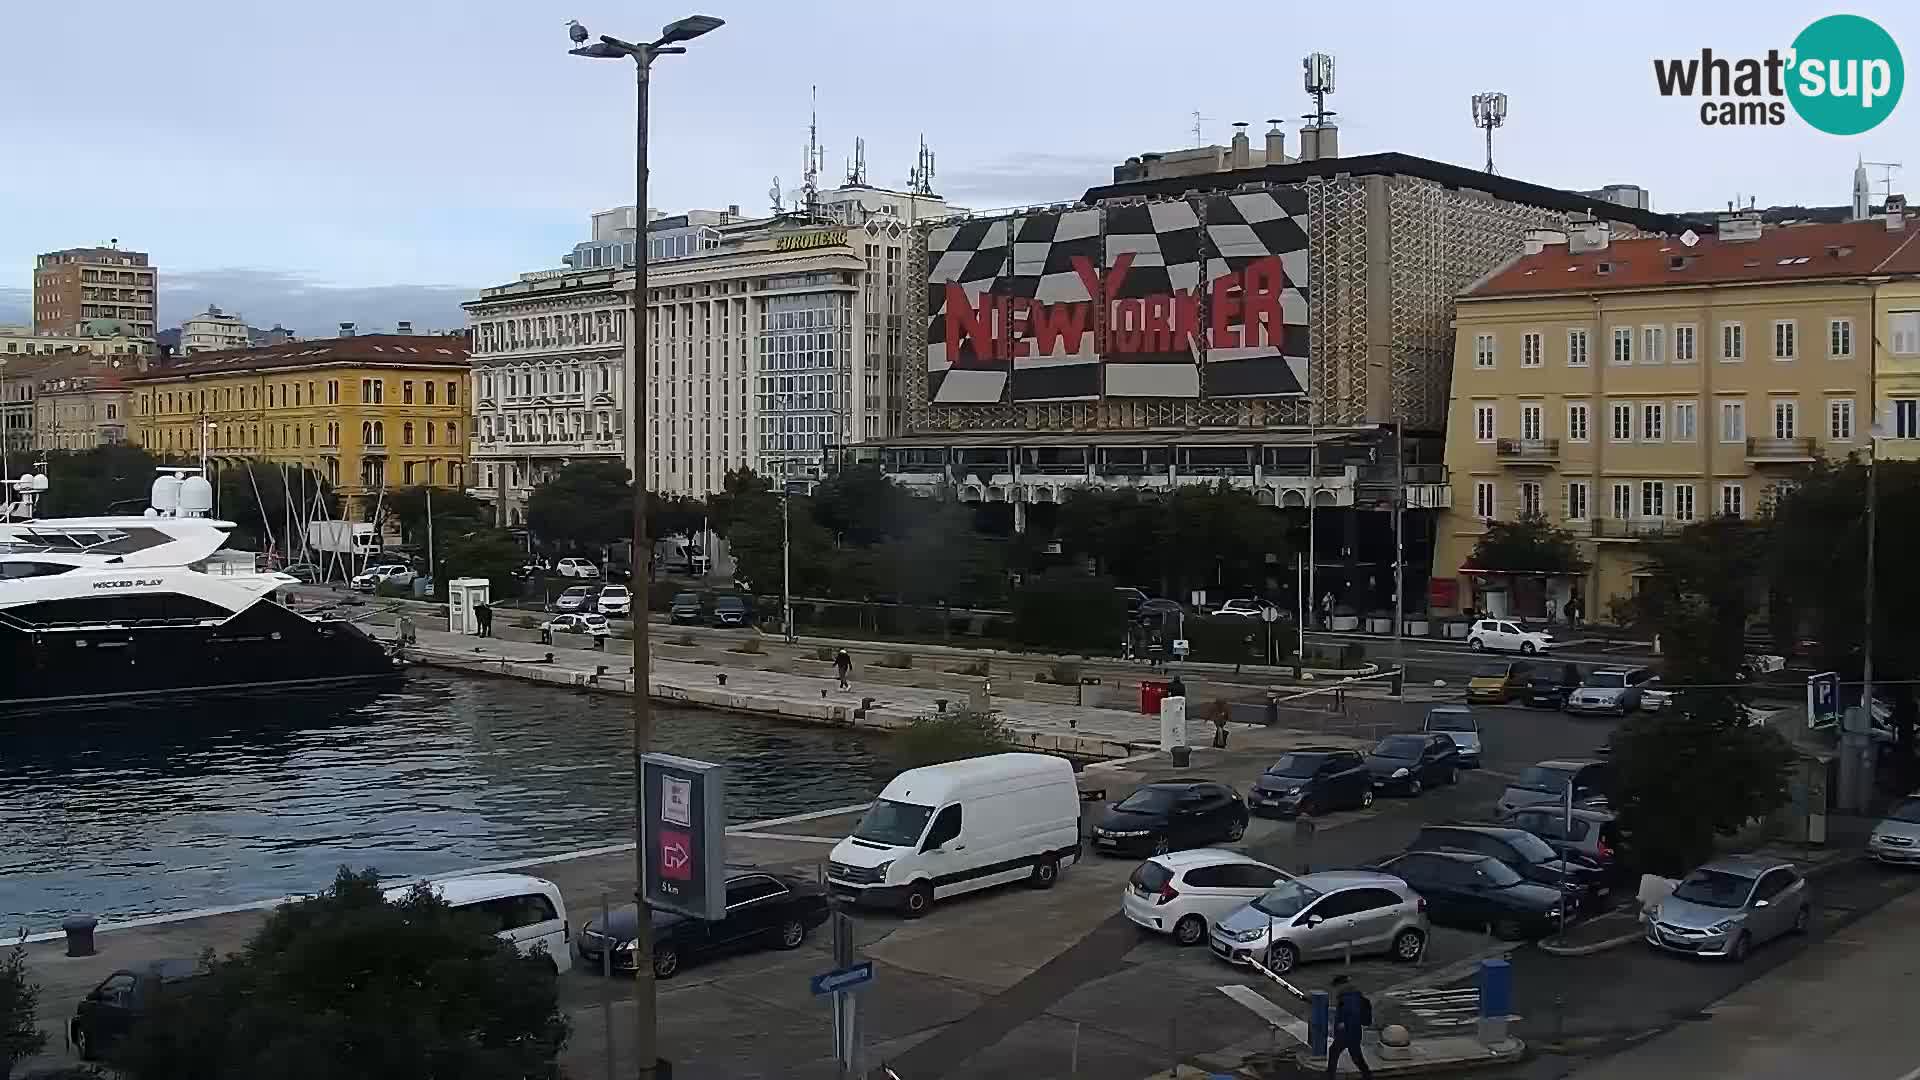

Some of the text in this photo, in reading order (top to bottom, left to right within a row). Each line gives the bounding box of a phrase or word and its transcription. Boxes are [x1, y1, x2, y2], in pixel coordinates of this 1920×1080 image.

[945, 252, 1284, 364] NEW YORKER
[93, 579, 163, 589] WICKED PLAY
[1819, 680, 1831, 705] P
